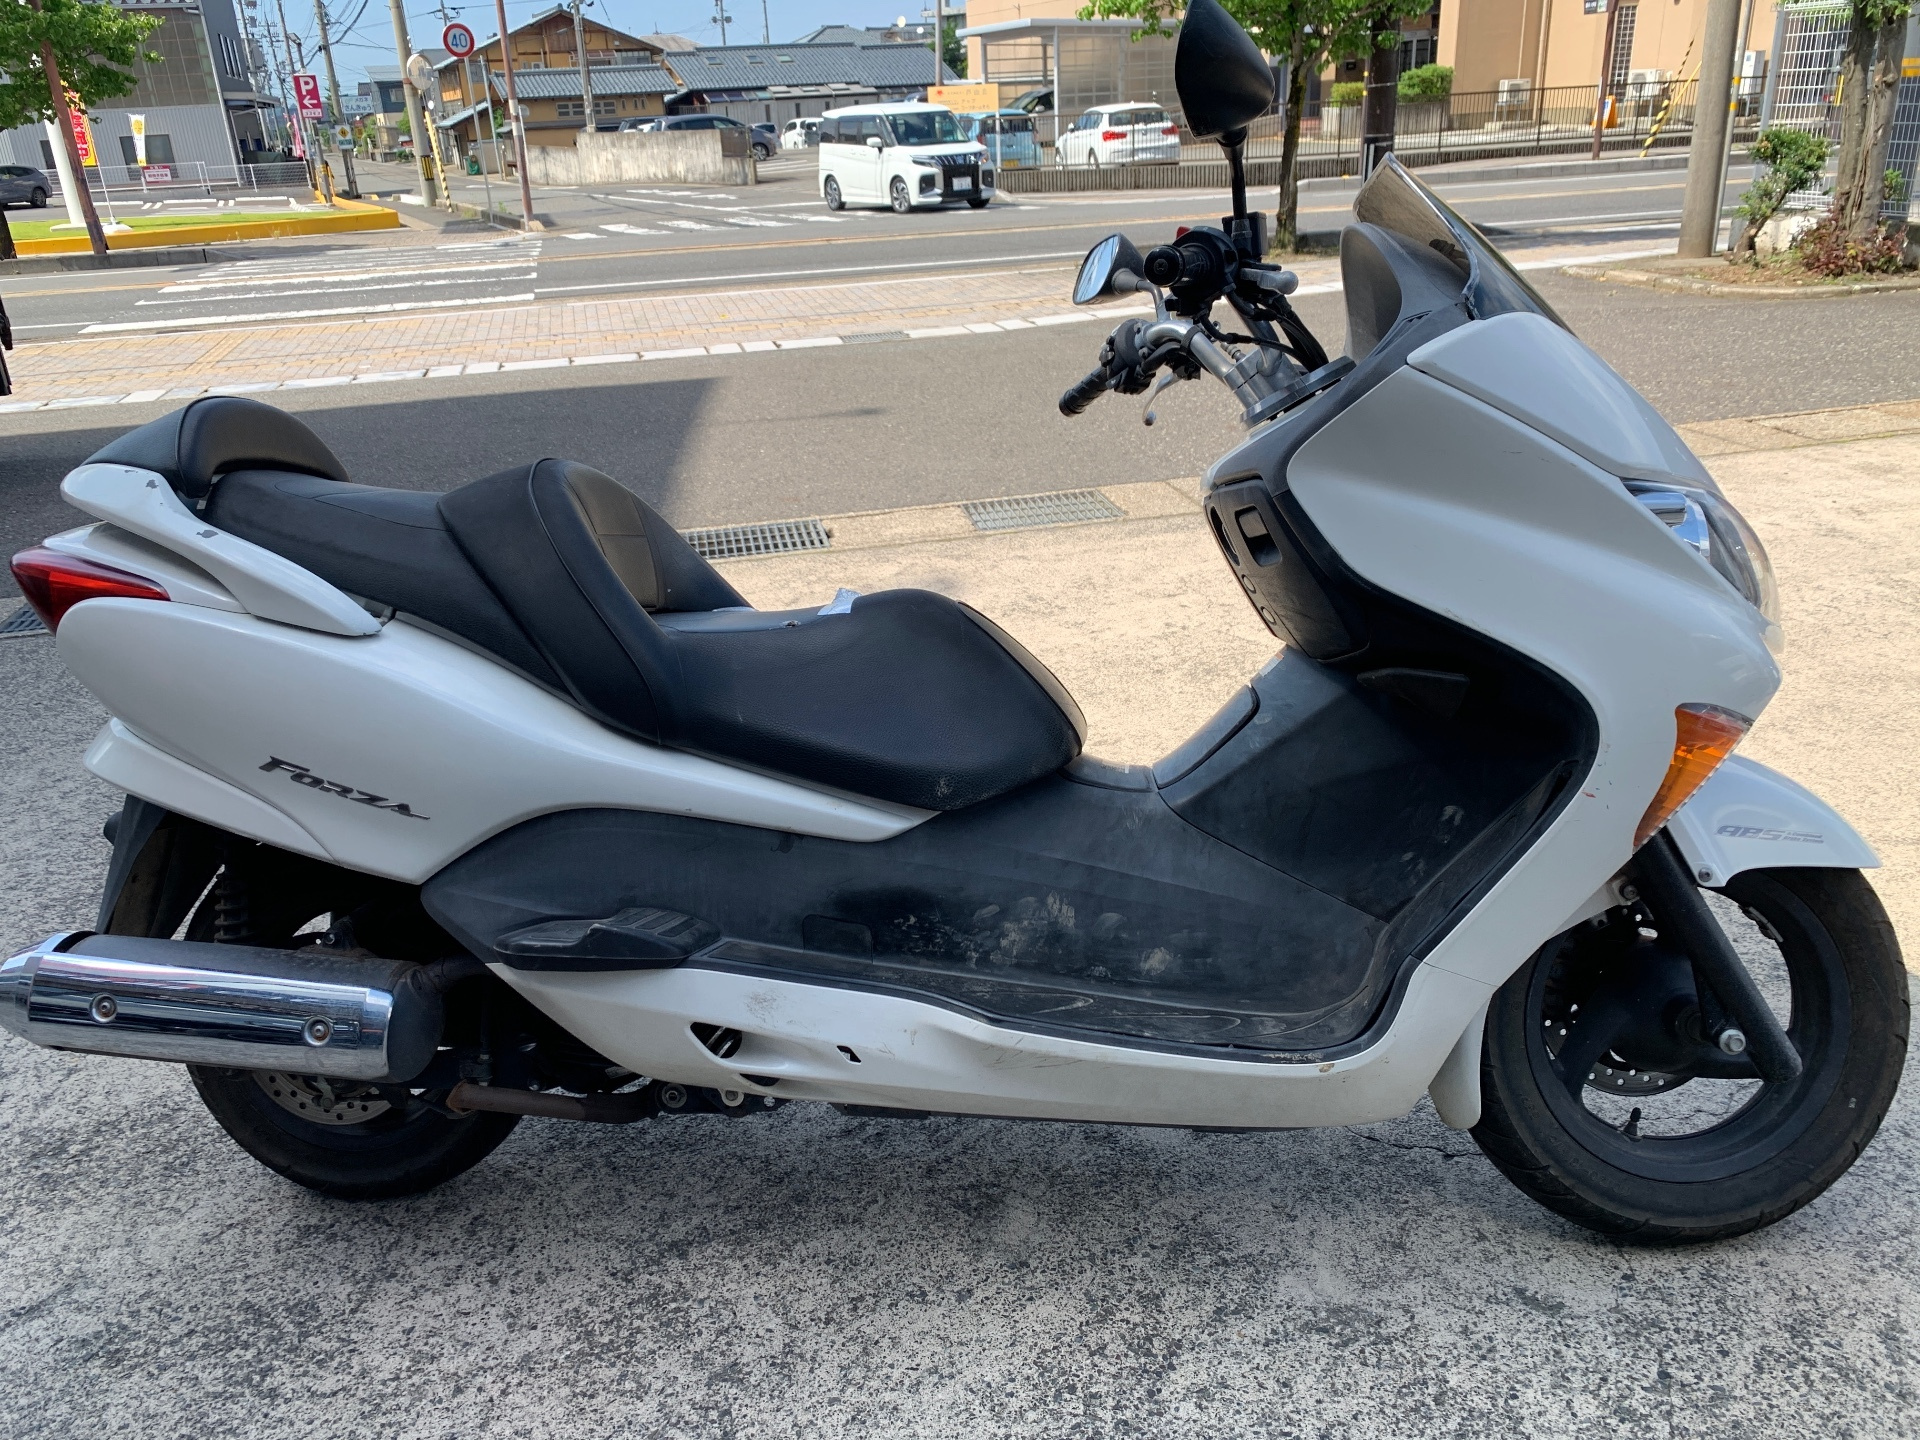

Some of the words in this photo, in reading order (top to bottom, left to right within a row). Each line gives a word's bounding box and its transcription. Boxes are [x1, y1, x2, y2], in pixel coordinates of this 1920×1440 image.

[451, 33, 468, 48] 40
[299, 77, 314, 95] P
[1716, 825, 1786, 841] ABS
